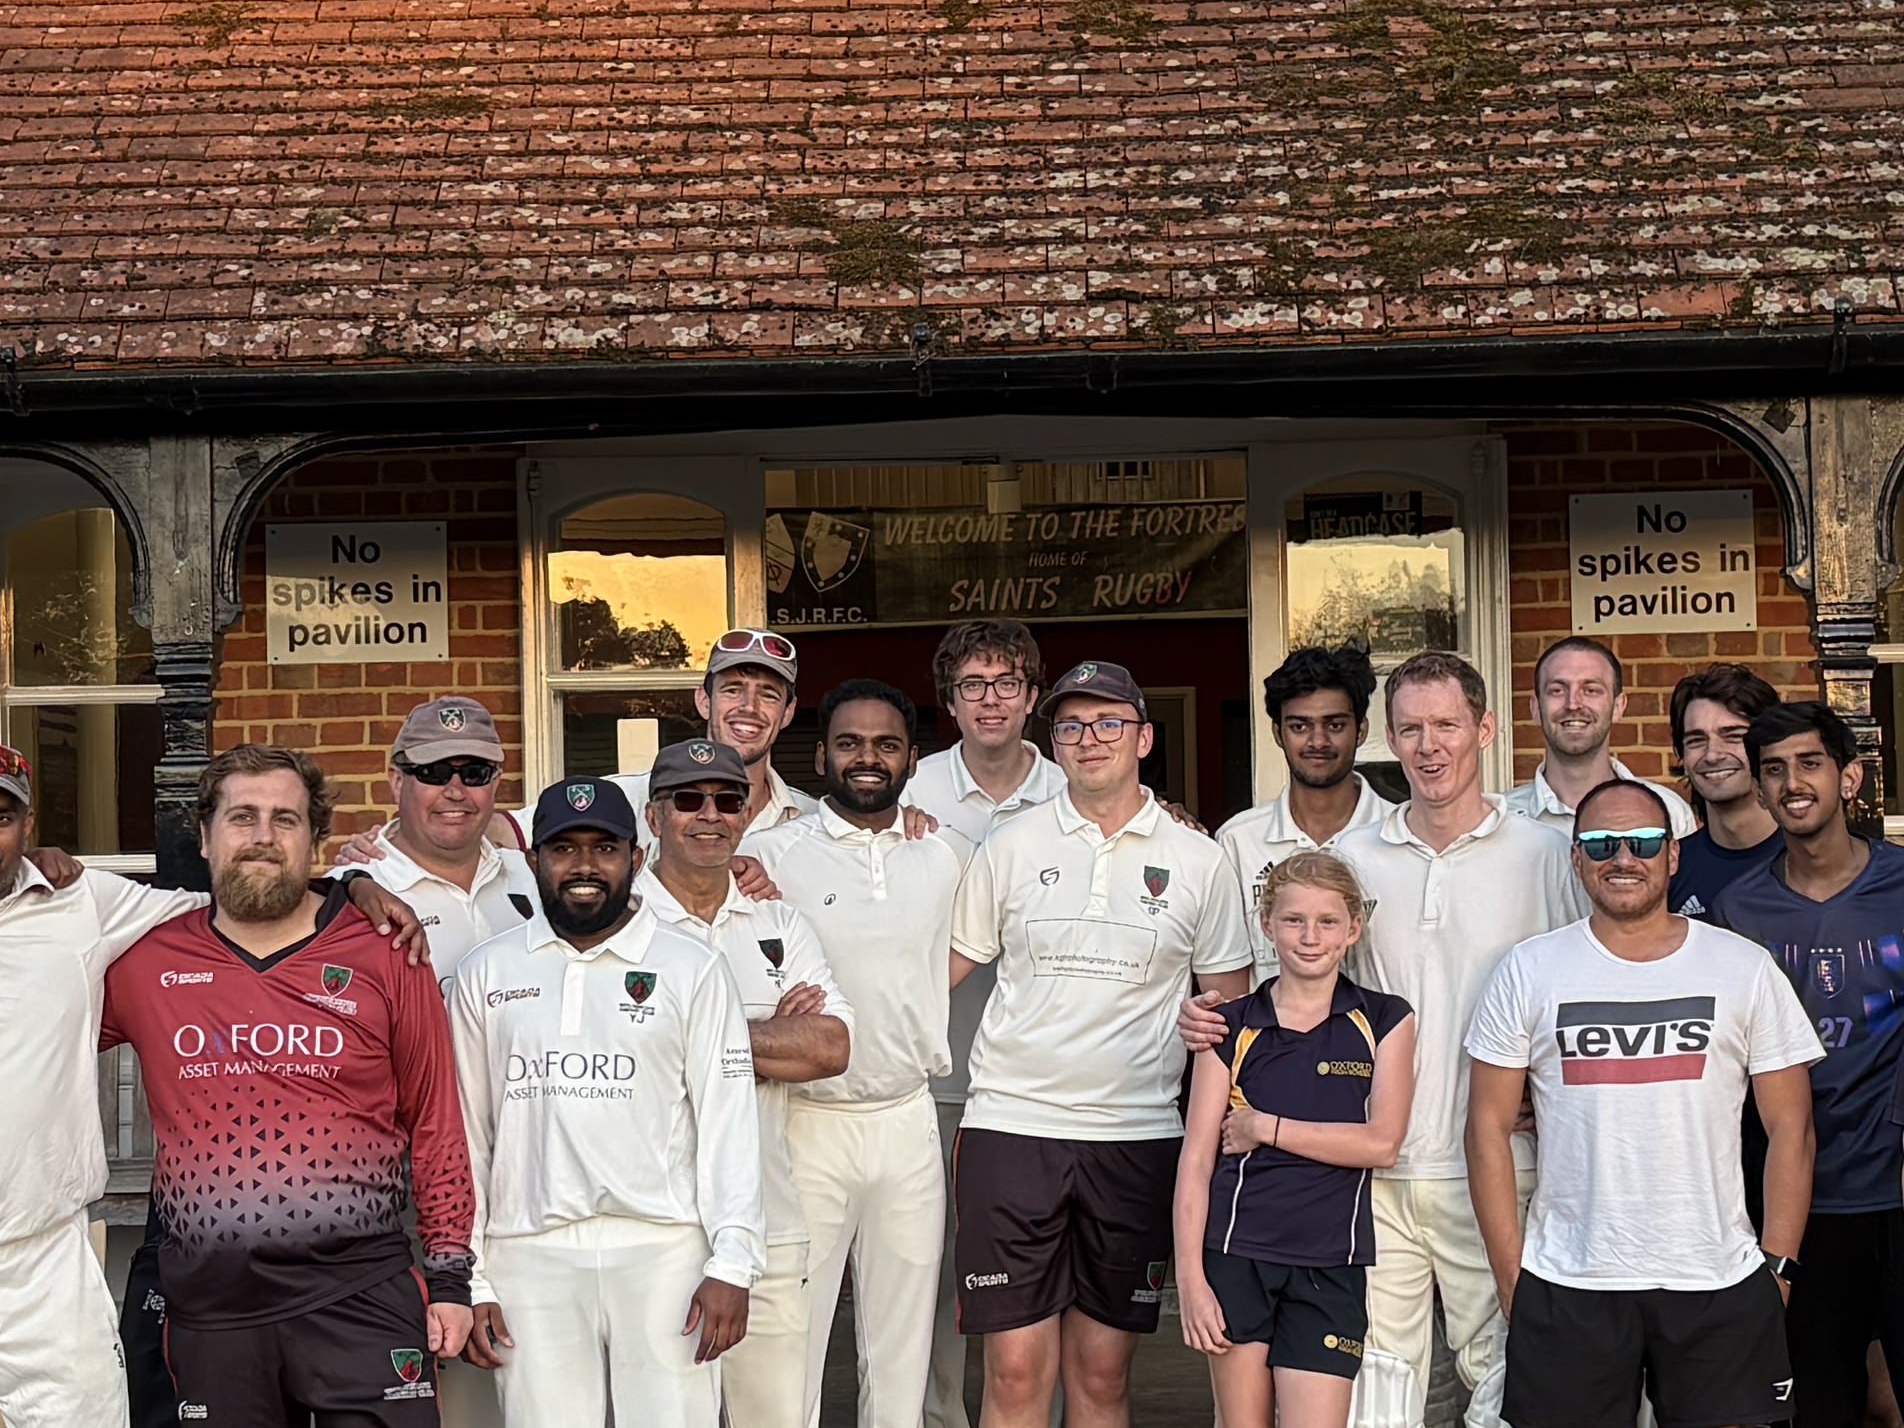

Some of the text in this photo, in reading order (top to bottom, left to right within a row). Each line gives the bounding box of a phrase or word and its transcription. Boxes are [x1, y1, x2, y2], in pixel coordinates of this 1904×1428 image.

[883, 503, 1245, 546] WELCOME TO THE FORTRES
[1637, 504, 1687, 533] No
[332, 535, 381, 563] No
[1028, 551, 1088, 567] HOME OF
[1578, 543, 1749, 582] spikes in
[272, 574, 441, 611] spikes in
[949, 571, 1192, 613] SAINTS RUGBY
[1594, 585, 1735, 623] pavilion
[771, 606, 868, 624] .S.J.R.F.C.
[289, 615, 427, 652] pavilion
[173, 1023, 344, 1057] OFORD
[1818, 1016, 1854, 1048] 27
[178, 1062, 219, 1080] ASSET
[504, 1085, 538, 1102] ASSET
